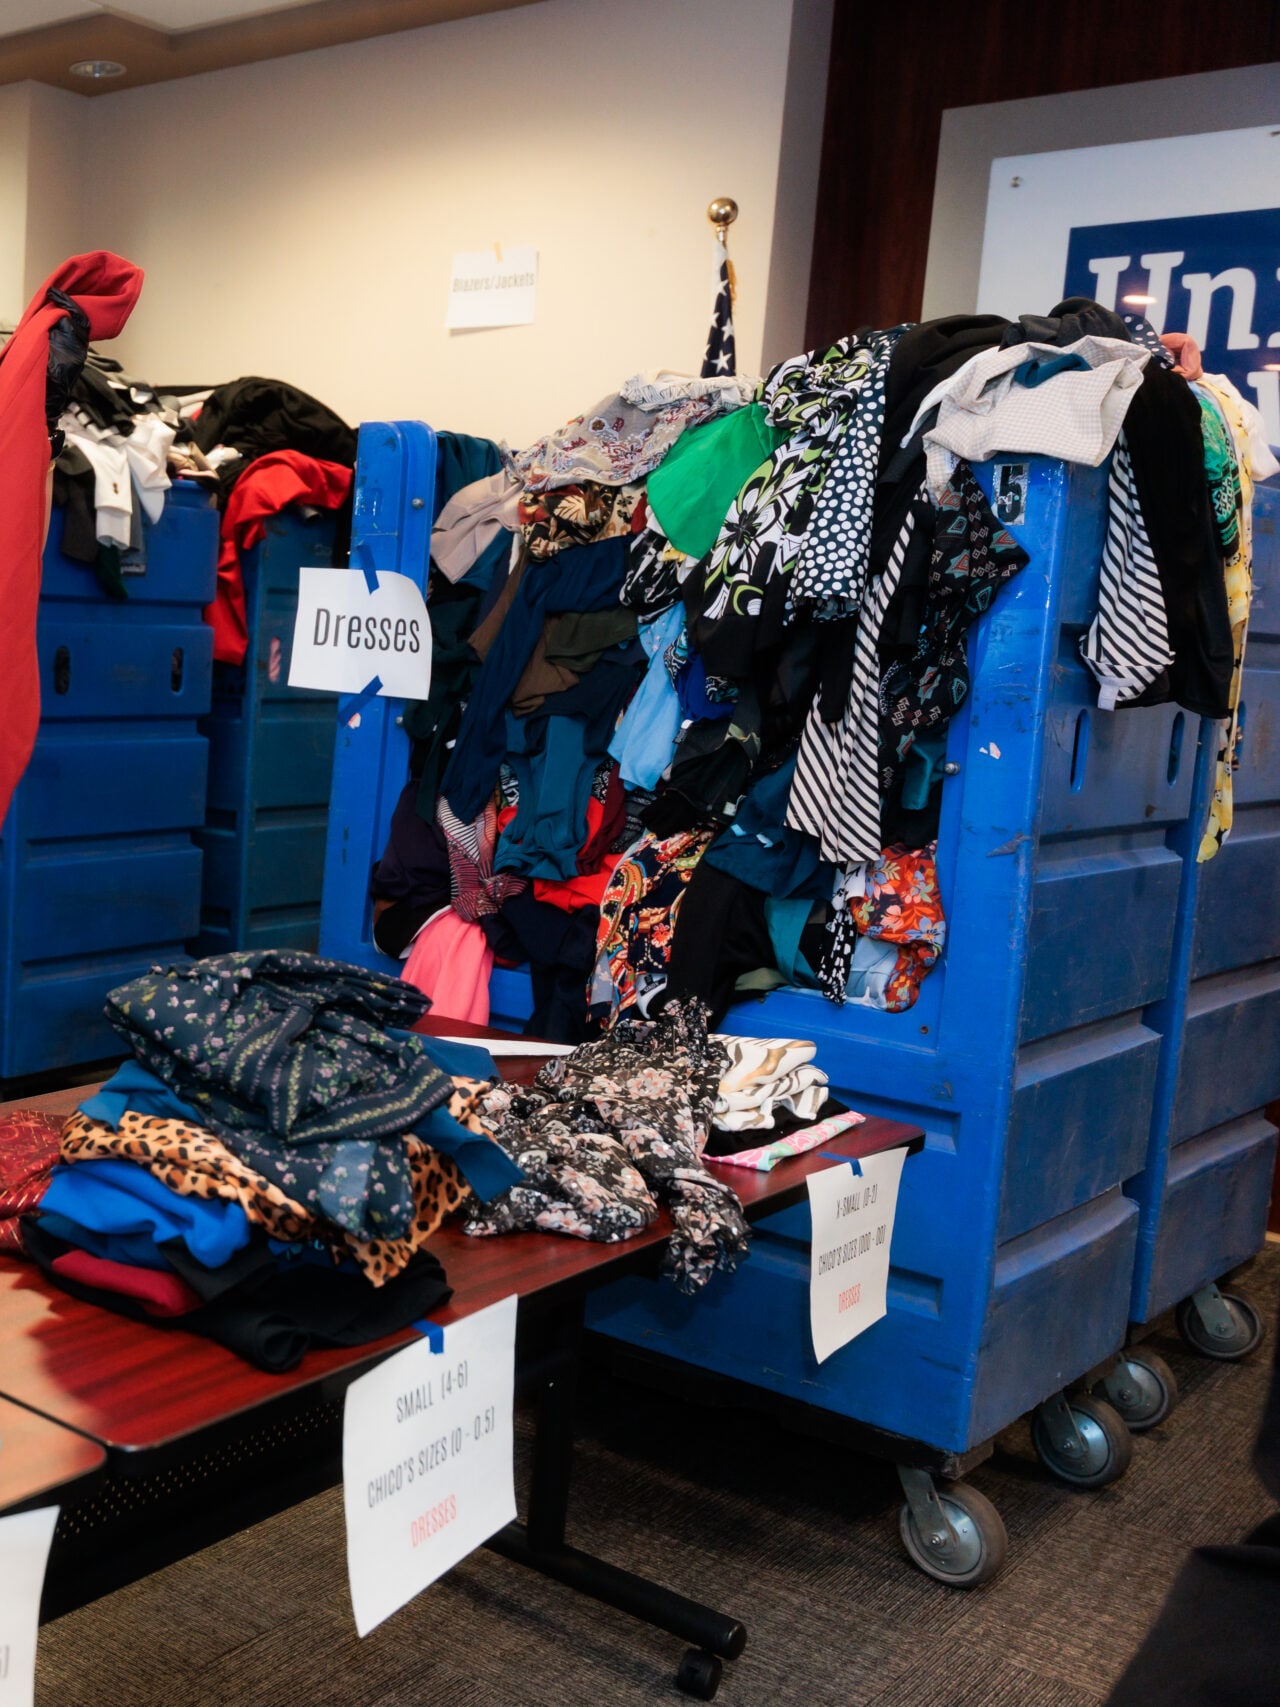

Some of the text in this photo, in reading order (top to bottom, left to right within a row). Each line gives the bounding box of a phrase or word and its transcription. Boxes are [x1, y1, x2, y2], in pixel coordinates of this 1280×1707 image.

[1088, 251, 1280, 351] Un
[313, 607, 420, 653] Dresses
[836, 1190, 860, 1219] X-SMALL
[819, 1246, 842, 1276] CHICO'S
[842, 1238, 858, 1264] SIZES
[838, 1283, 862, 1313] DRESSES
[396, 1360, 468, 1424] SMALL (4-6)
[368, 1456, 415, 1509] CHICO'S
[418, 1436, 448, 1477] SIZES
[451, 1426, 462, 1458] (0
[474, 1406, 496, 1441] 0.5)
[410, 1493, 458, 1548] DRESSES
